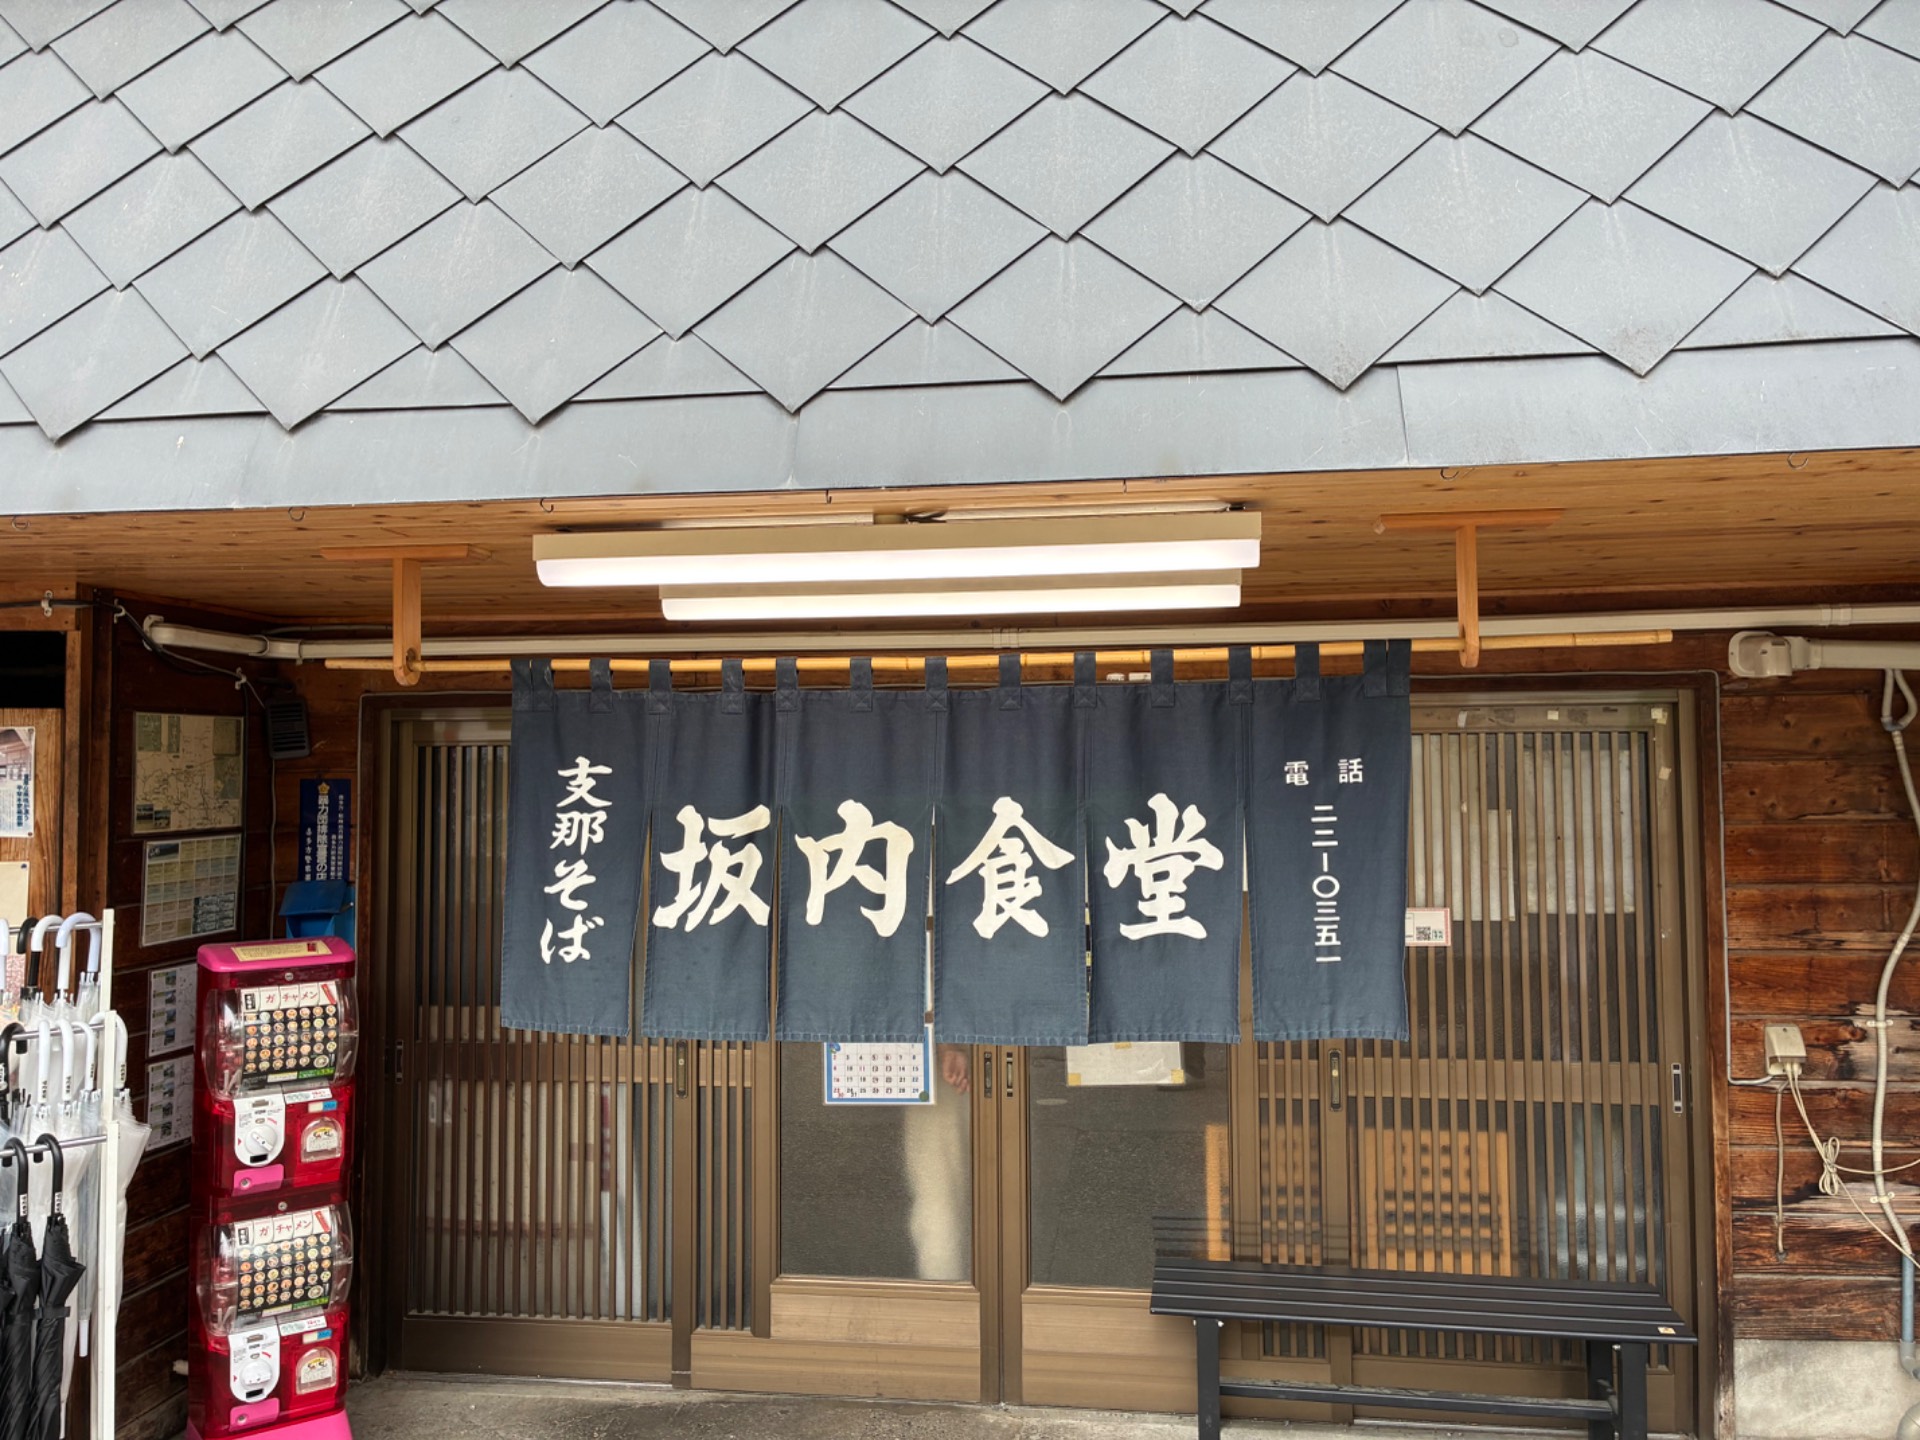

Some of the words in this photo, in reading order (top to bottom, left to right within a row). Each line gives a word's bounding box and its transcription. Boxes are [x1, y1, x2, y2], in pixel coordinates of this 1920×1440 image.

[1284, 758, 1364, 786] 電話
[540, 756, 613, 964] 支那そば
[652, 793, 1224, 940] 坂内食堂
